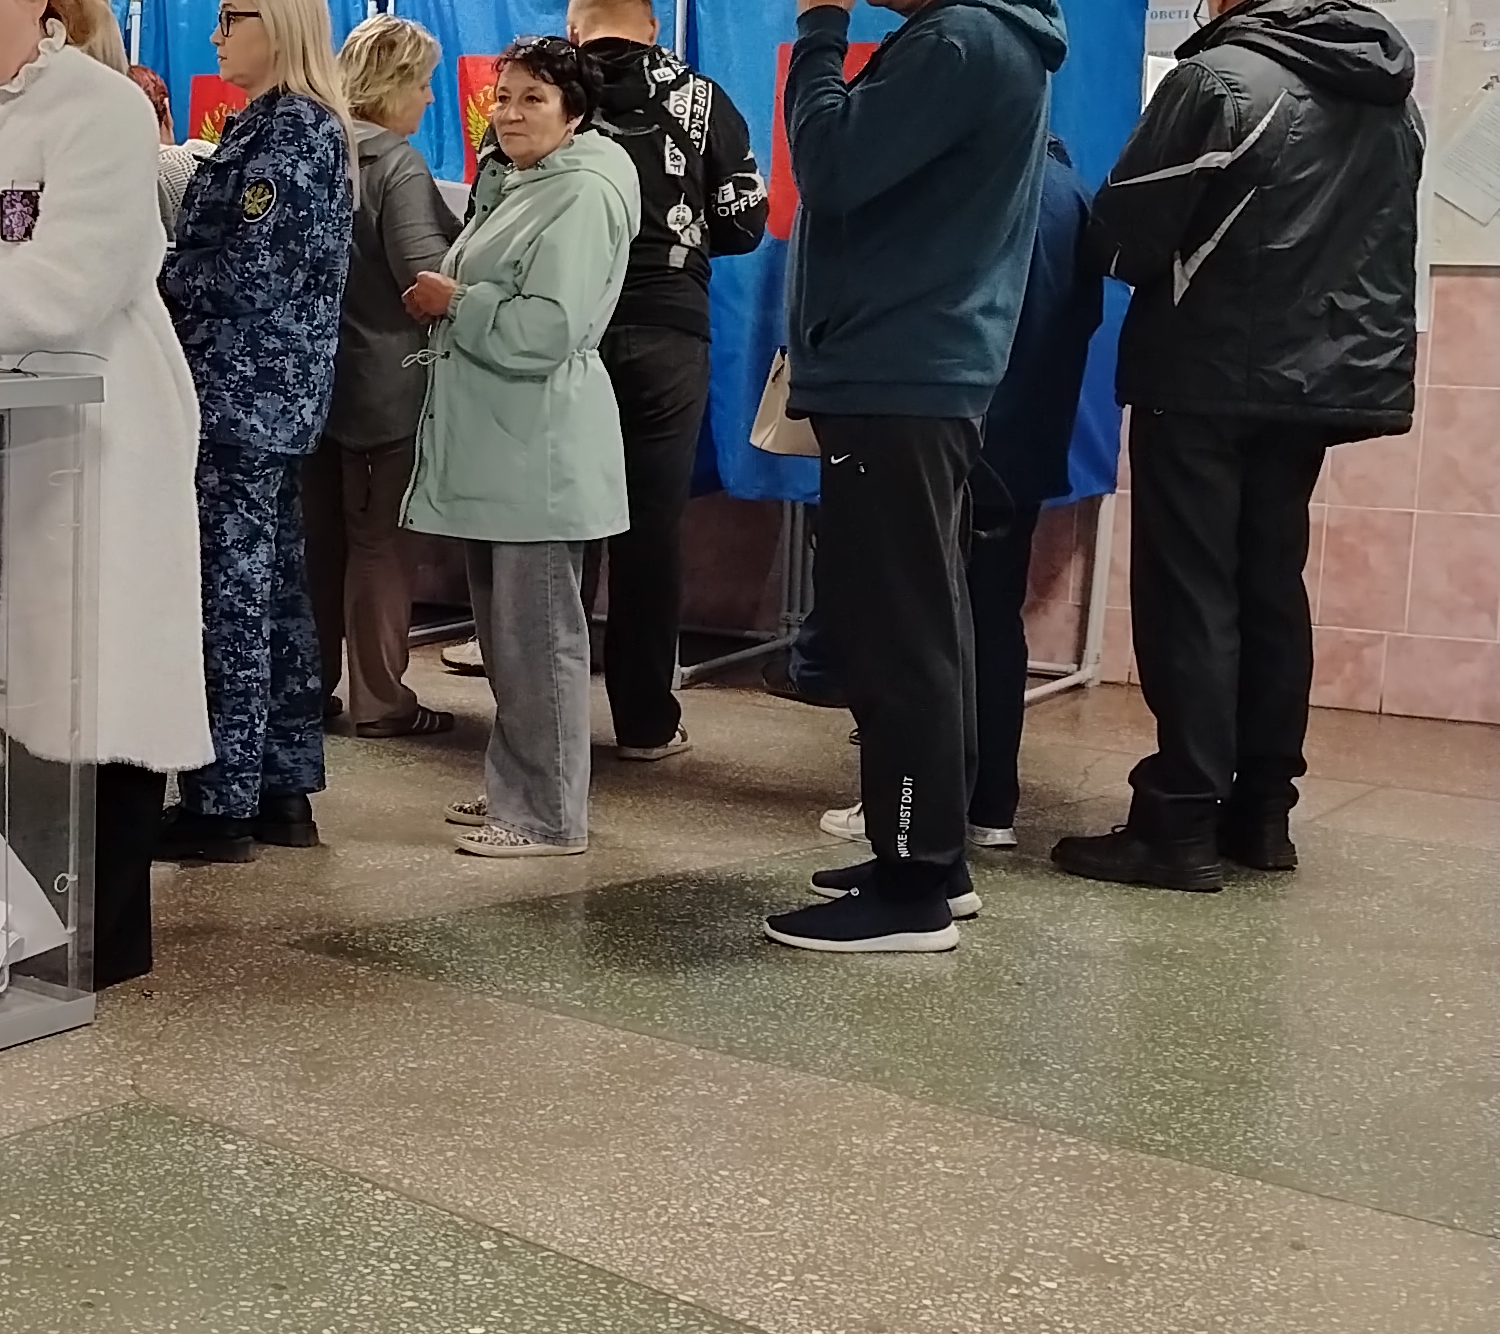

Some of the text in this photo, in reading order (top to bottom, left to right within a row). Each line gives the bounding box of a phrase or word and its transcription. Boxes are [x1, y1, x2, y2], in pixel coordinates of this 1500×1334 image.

[897, 775, 914, 858] NIKE JUST DO IT
